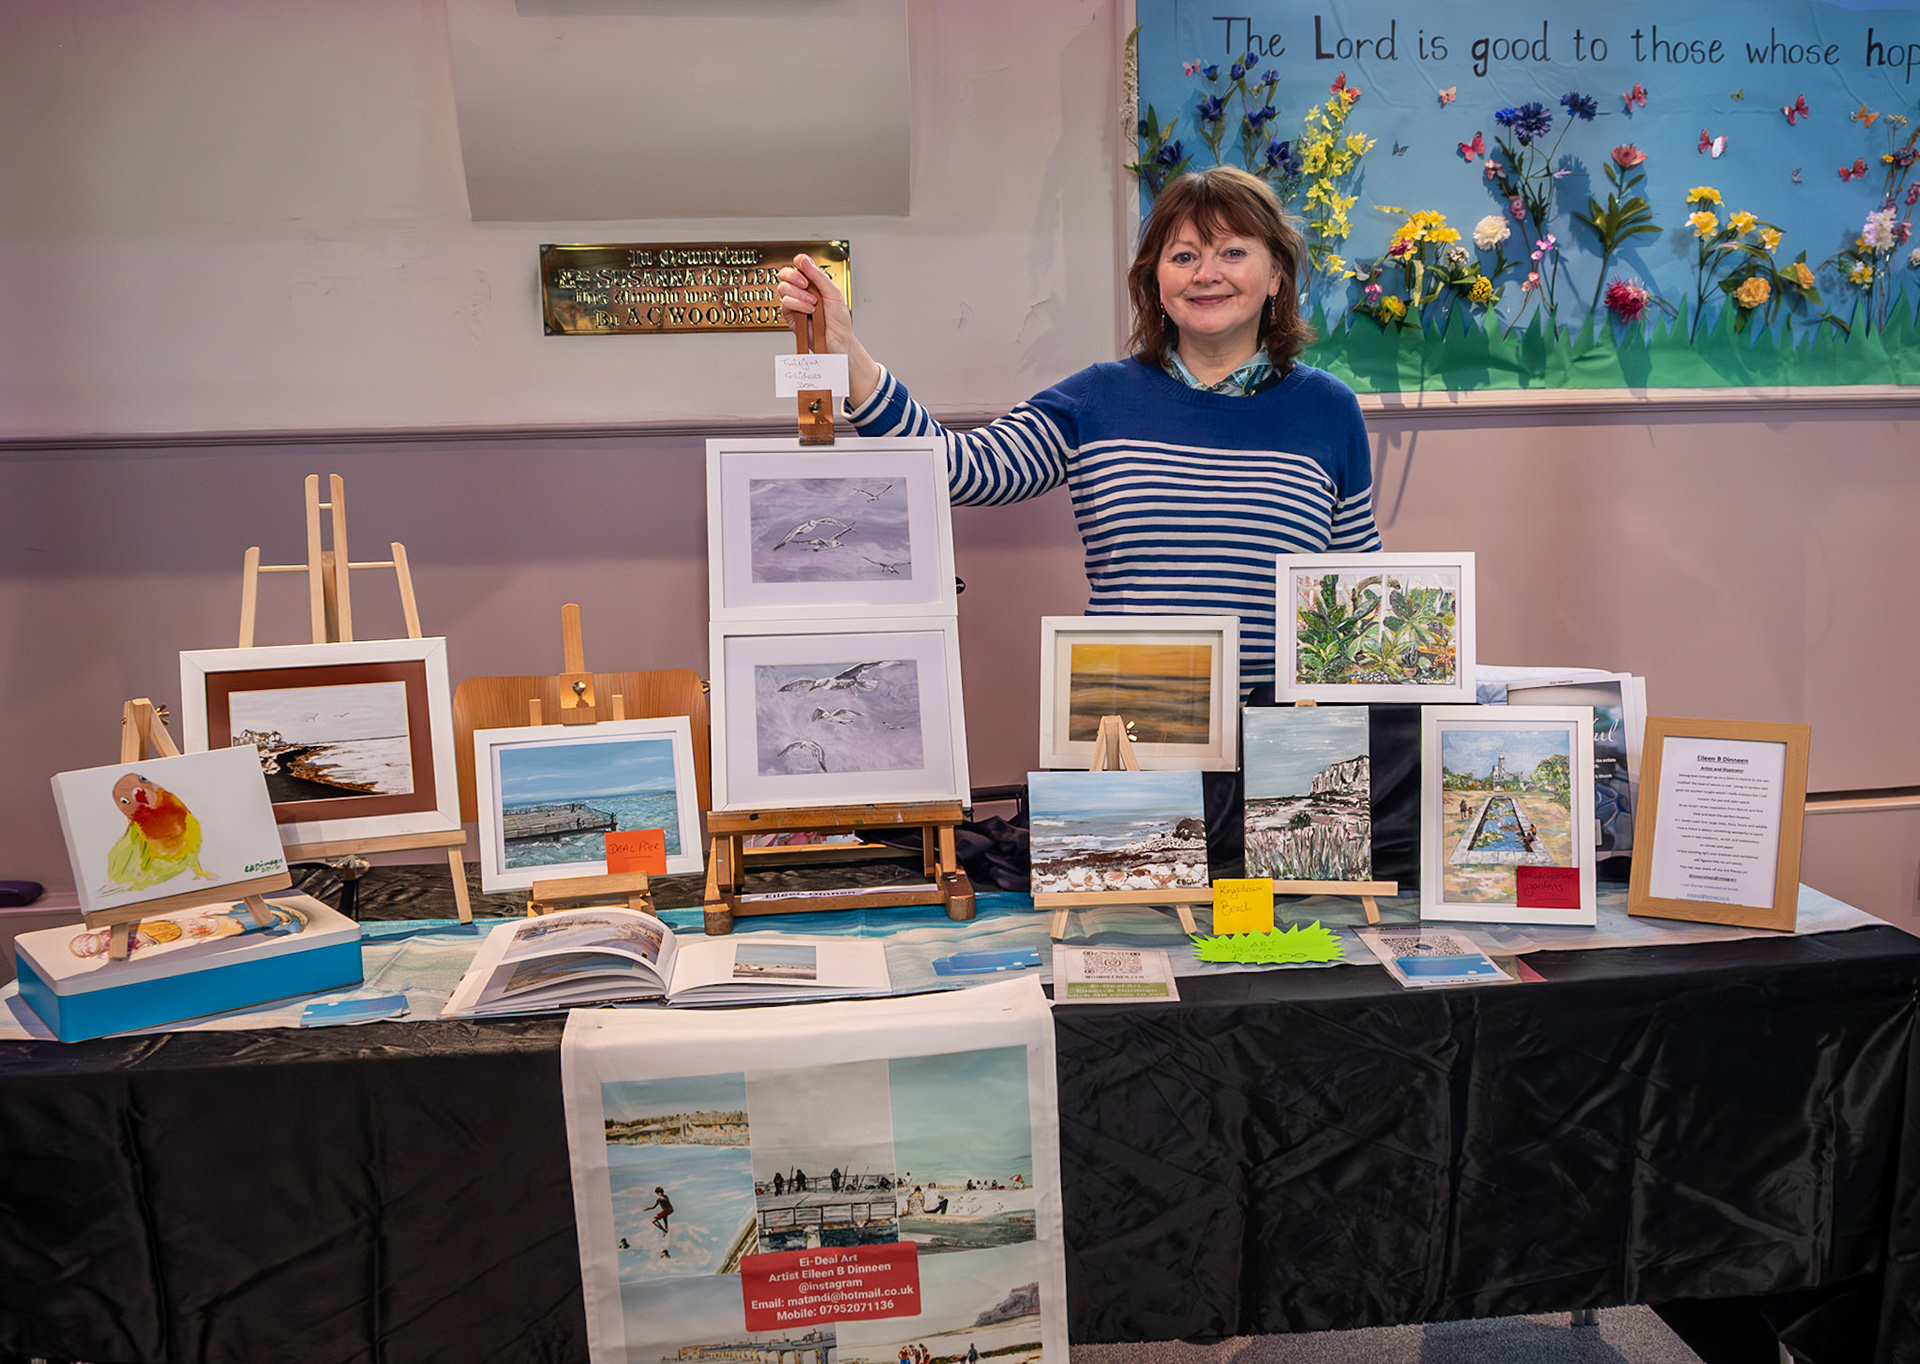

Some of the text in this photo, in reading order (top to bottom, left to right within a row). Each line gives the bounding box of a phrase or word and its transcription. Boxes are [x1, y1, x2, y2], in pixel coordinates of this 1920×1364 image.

[1213, 16, 1286, 57] The
[1314, 15, 1398, 60] Lord
[1419, 29, 1448, 60] is
[1471, 20, 1549, 77] good
[1573, 27, 1608, 62] to
[1632, 25, 1724, 64] those
[1746, 27, 1839, 65] whose
[595, 268, 698, 289] SUSANNA
[702, 267, 779, 287] KEELER
[685, 288, 718, 304] was
[626, 307, 643, 327] A
[647, 307, 662, 326] C
[1221, 900, 1253, 917] Beach
[799, 1254, 858, 1267] Ei-Deal Art
[768, 1262, 891, 1283] Artist Eileen B Dinneen
[798, 1278, 863, 1294] @instagram
[751, 1285, 914, 1310] Email: matandi@hotmail.co.uk
[776, 1299, 894, 1321] Mobile: 07952071136
